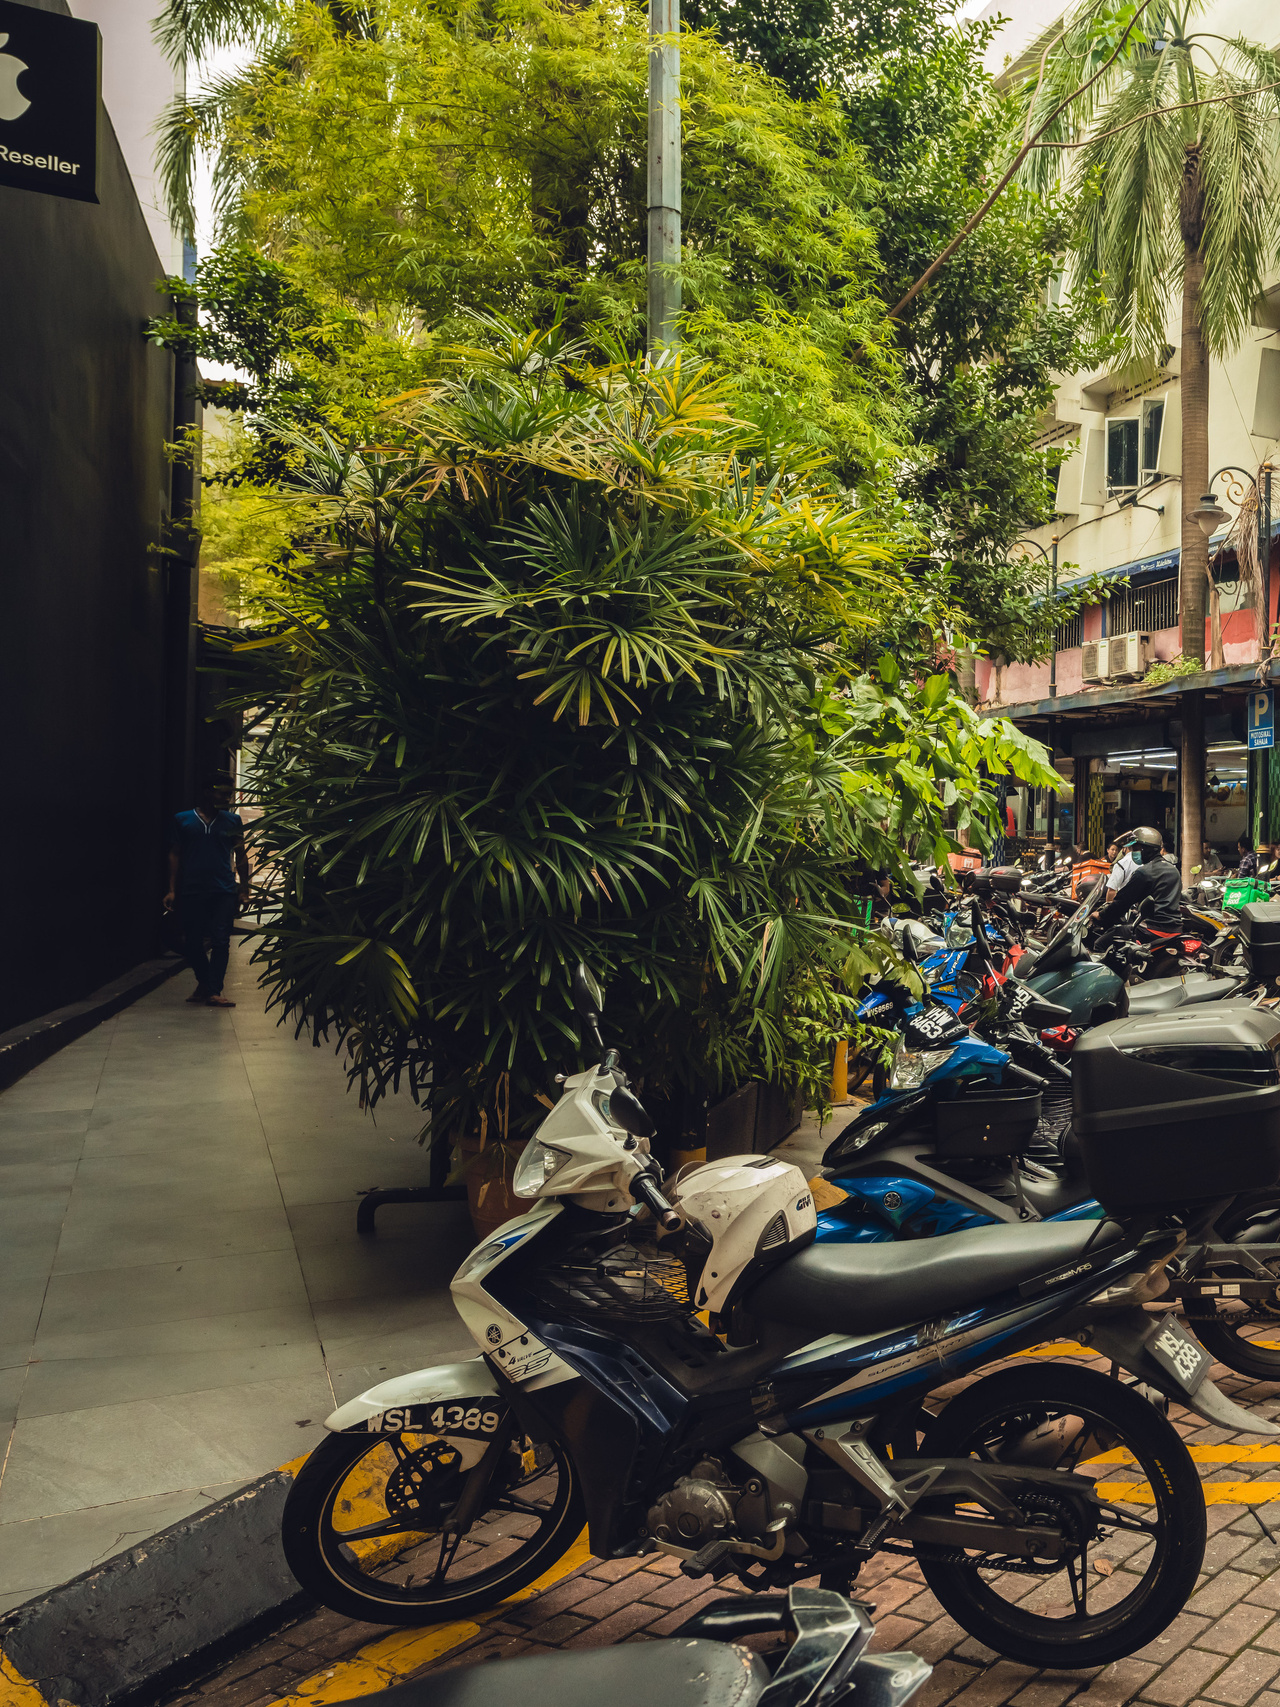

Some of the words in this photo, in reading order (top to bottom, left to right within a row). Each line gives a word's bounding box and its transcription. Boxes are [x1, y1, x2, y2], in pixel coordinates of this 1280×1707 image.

[0, 144, 80, 175] Reseller
[1254, 693, 1269, 727] P
[909, 1015, 944, 1039] 8463
[925, 1006, 954, 1027] VHW
[1154, 1330, 1185, 1358] WSL
[867, 1358, 912, 1377] SUPER
[1173, 1343, 1202, 1381] 4389
[367, 1408, 423, 1432] WSL
[431, 1406, 500, 1433] 4389
